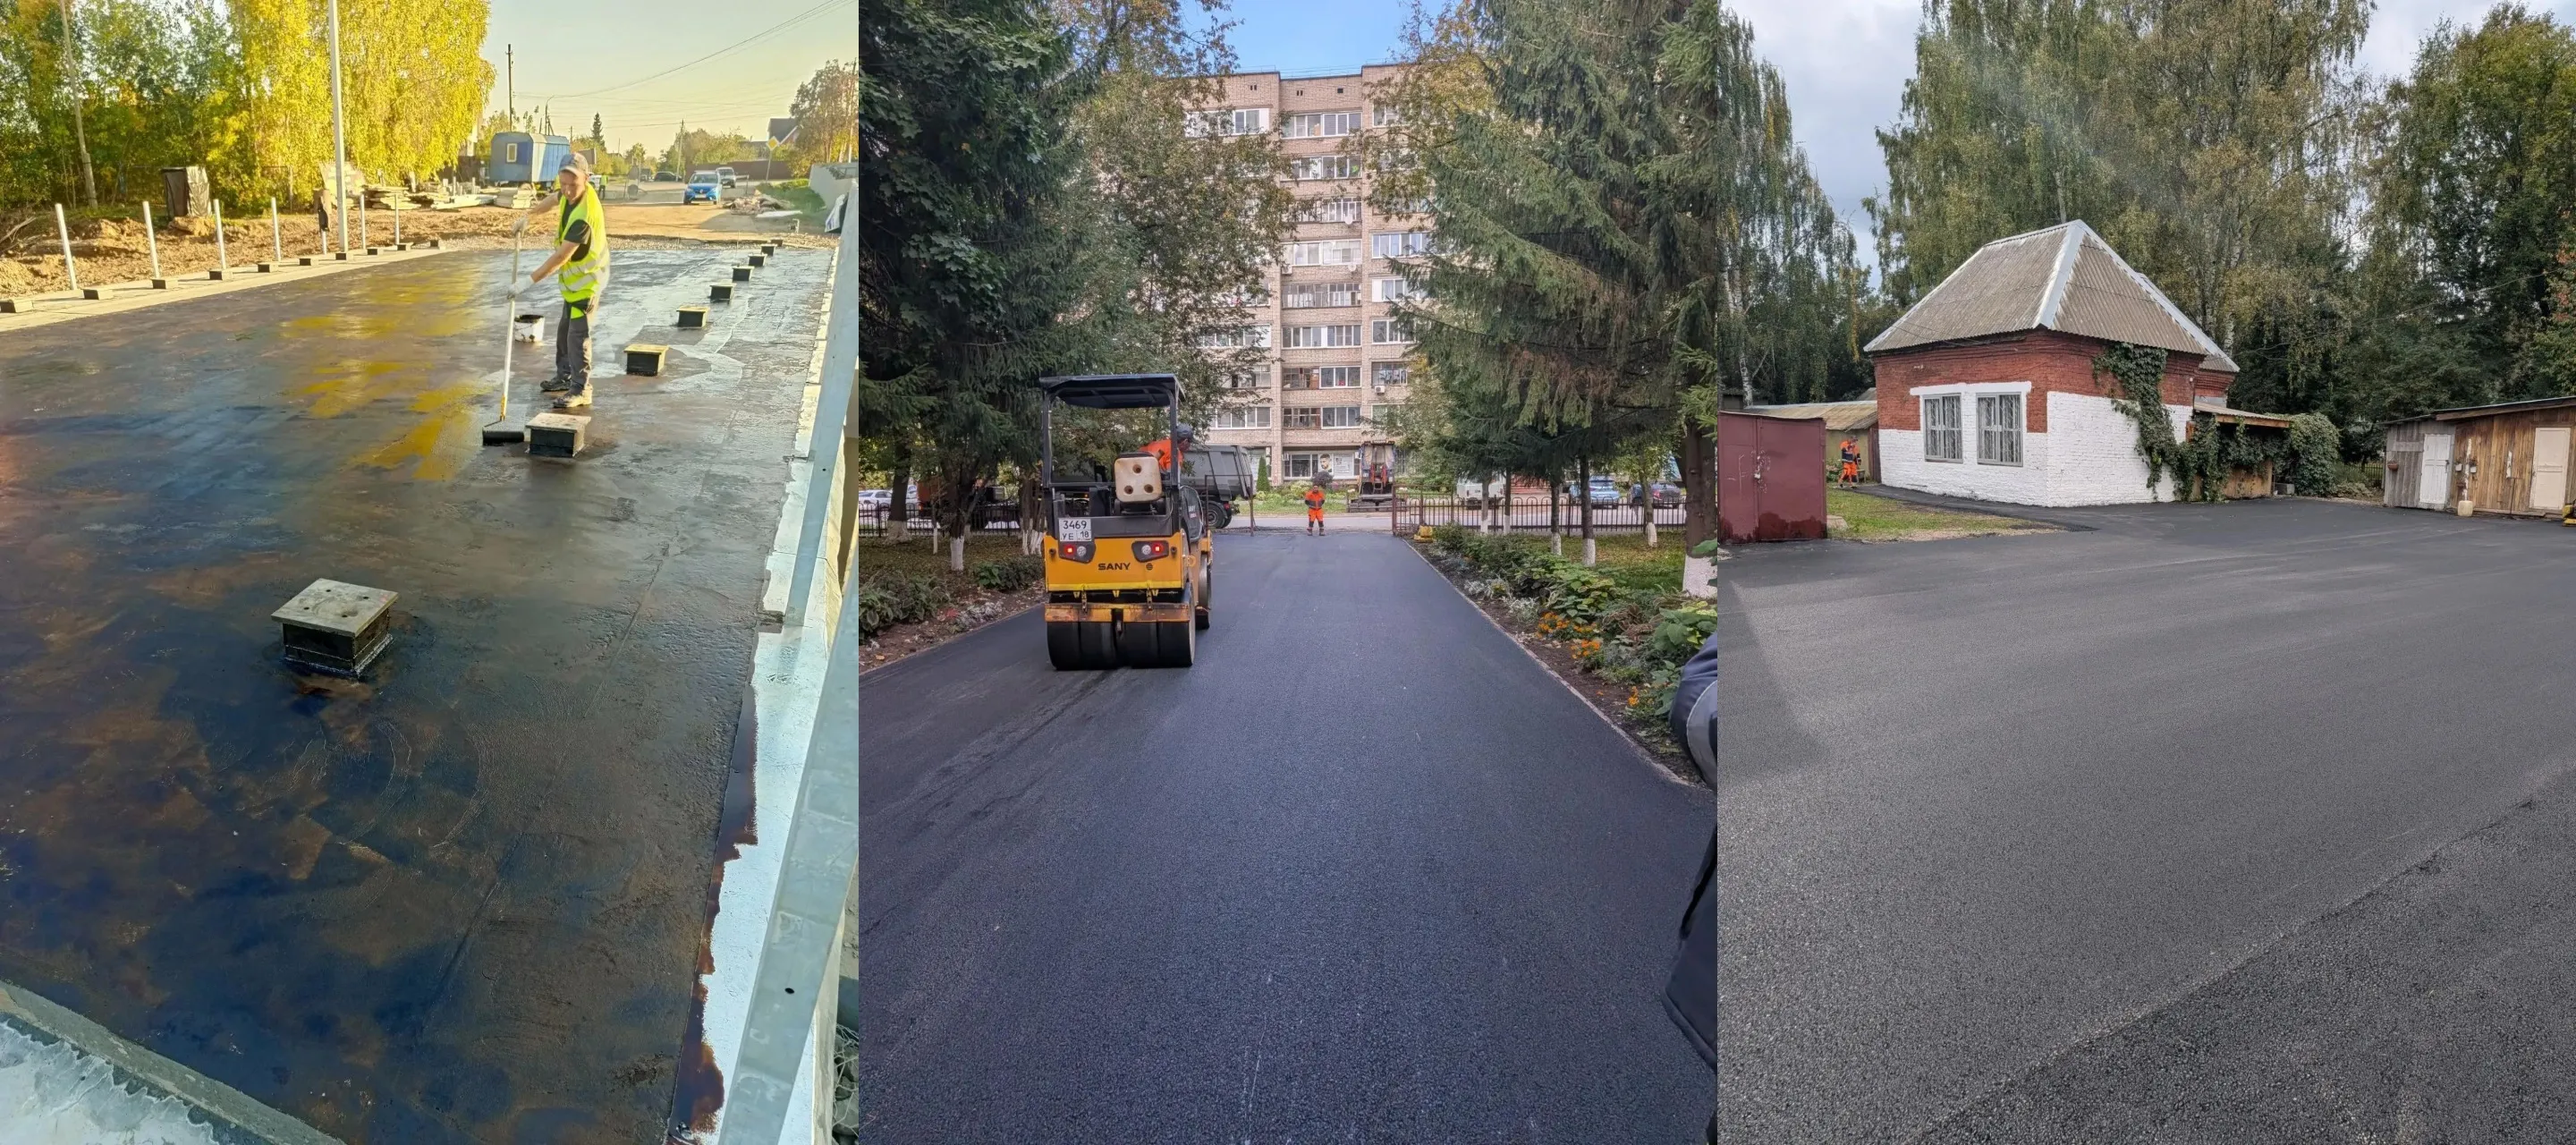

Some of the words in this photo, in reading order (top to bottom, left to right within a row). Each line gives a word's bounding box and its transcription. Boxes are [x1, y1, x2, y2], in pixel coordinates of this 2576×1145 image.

[1063, 520, 1088, 530] 3469
[1080, 530, 1089, 539] 18
[1097, 562, 1131, 571] SANY
